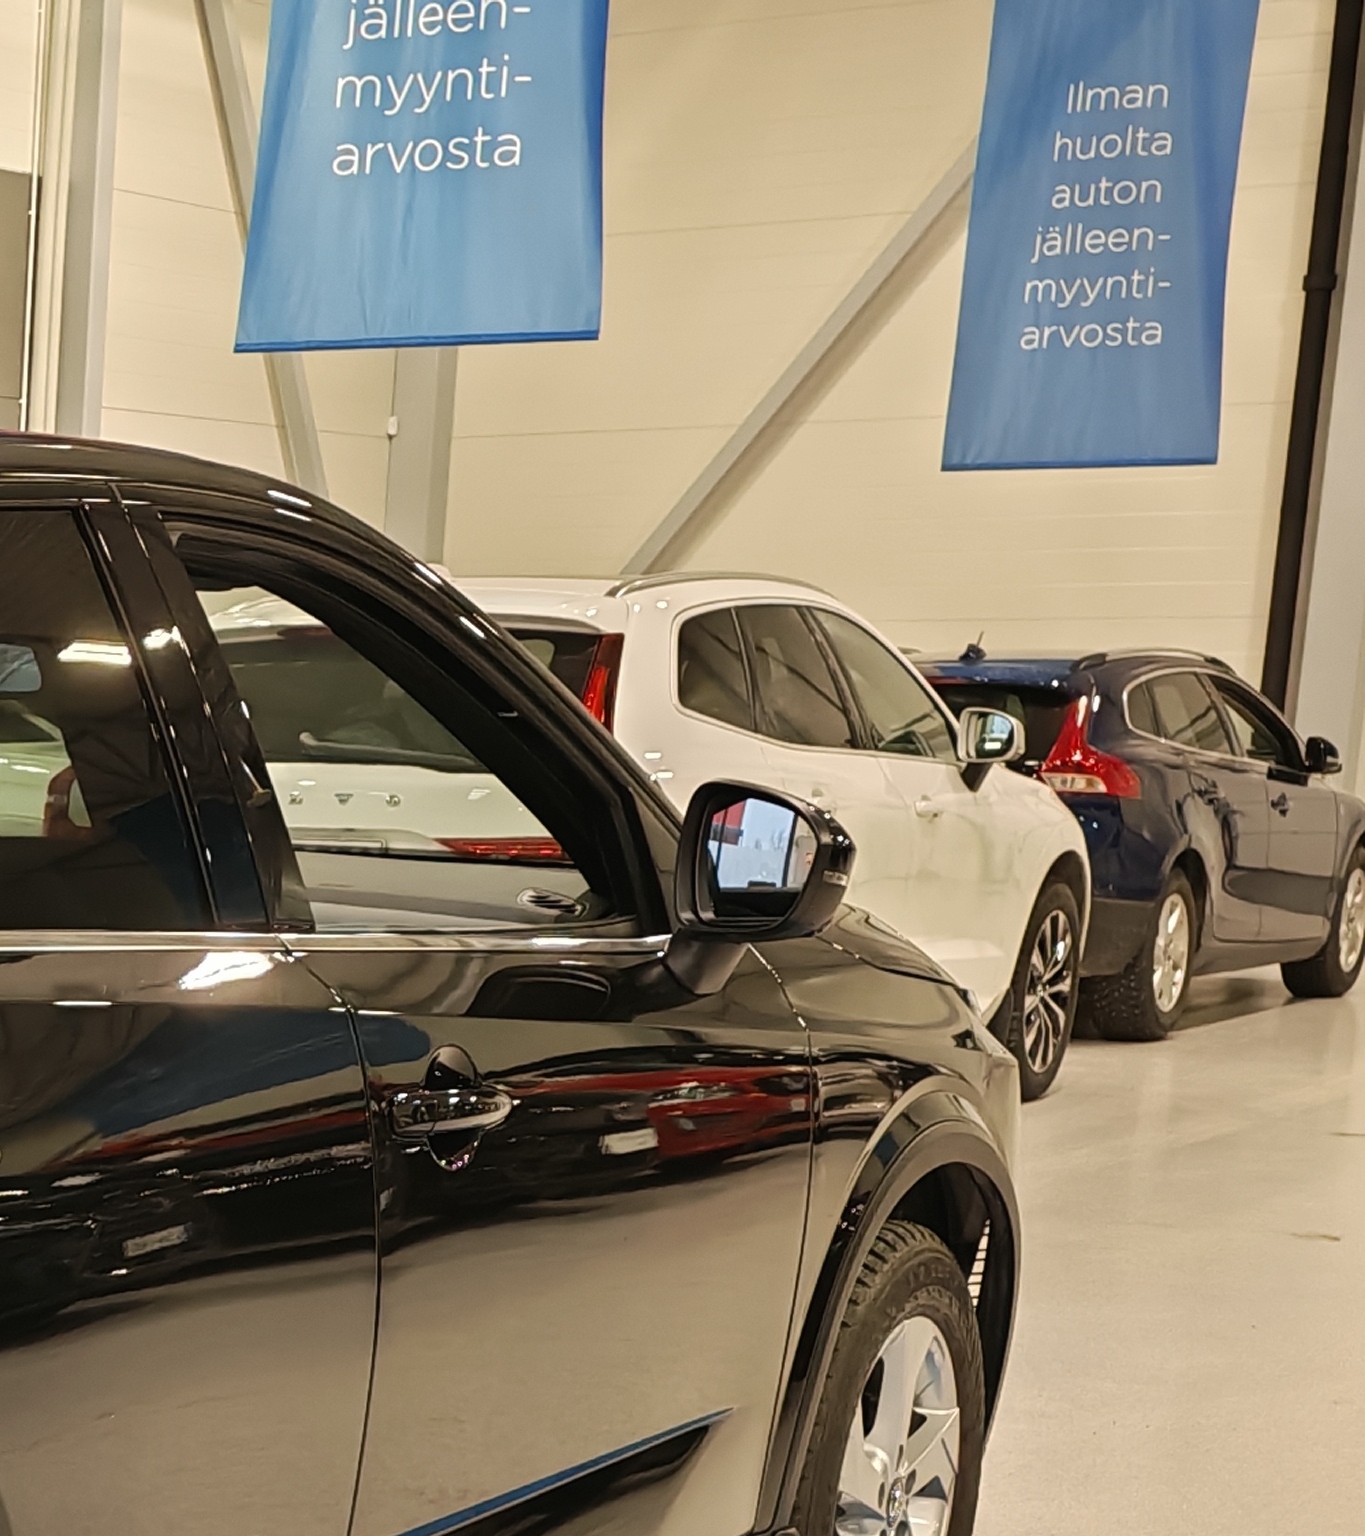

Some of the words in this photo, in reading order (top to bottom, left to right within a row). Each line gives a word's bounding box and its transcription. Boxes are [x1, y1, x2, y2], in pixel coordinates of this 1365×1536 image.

[342, 0, 532, 50] jälleen-
[335, 53, 533, 116] myynti-
[1066, 80, 1170, 115] Ilman
[331, 126, 522, 176] arvosta
[1052, 124, 1174, 163] huolta
[1051, 176, 1163, 209] auton
[1030, 222, 1172, 264] jälleen-
[1023, 266, 1173, 308] myynti-
[1019, 315, 1163, 350] arvosta
